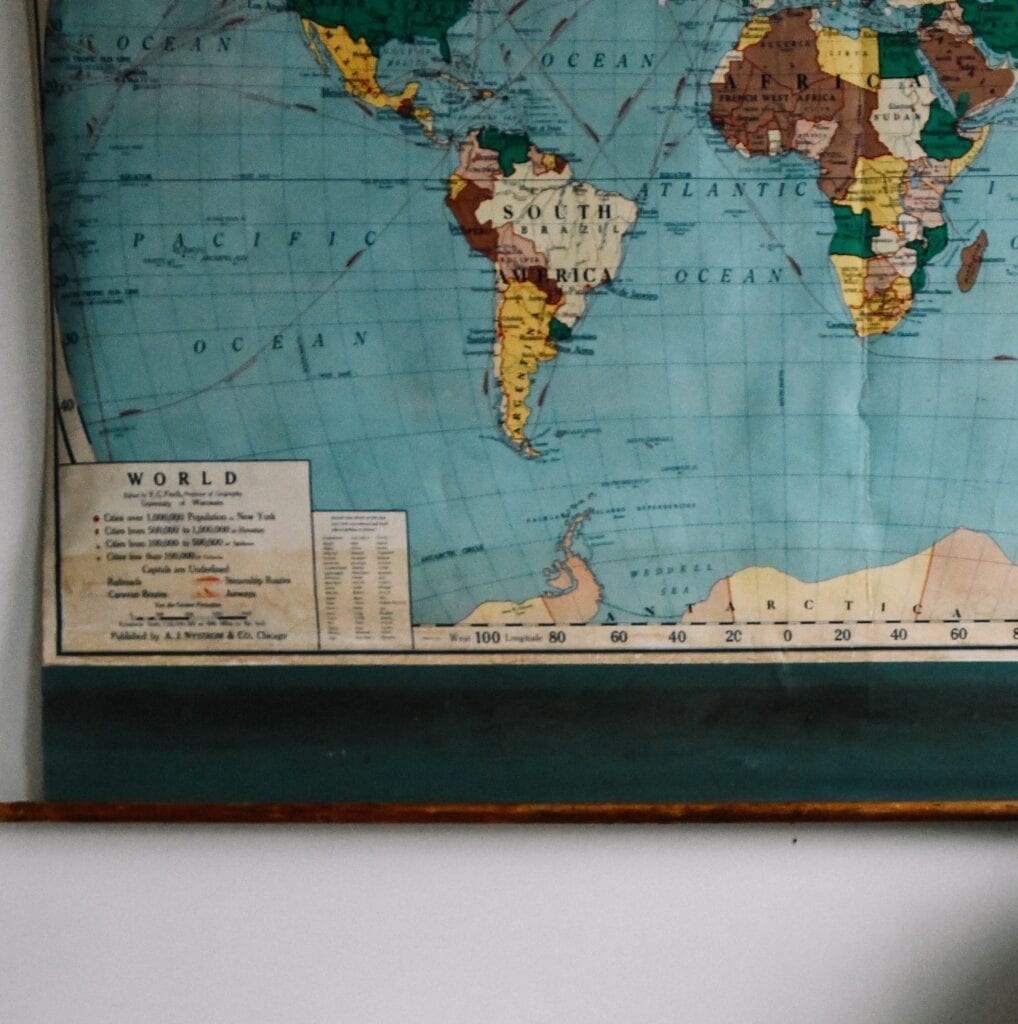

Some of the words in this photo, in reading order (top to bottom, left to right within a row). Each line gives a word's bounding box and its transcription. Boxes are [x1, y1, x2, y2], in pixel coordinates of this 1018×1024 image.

[117, 34, 231, 52] OCEAN
[540, 53, 655, 68] OCEAN
[724, 73, 924, 90] AFRICA
[873, 113, 921, 122] SUDAN
[637, 182, 807, 200] ATLANTIC
[503, 204, 612, 220] SOUTH
[521, 226, 620, 234] BRAZIL
[133, 230, 379, 248] PACIFIC
[675, 268, 783, 284] OCEAN
[193, 329, 368, 355] OCEAN
[127, 471, 238, 486] WORLD
[475, 631, 500, 644] 100
[548, 631, 566, 643] 80
[610, 630, 628, 643] 60
[668, 630, 686, 643] 40
[783, 630, 792, 641] 0
[834, 629, 851, 642] 20
[890, 628, 908, 641] 40
[950, 628, 968, 641] 60
